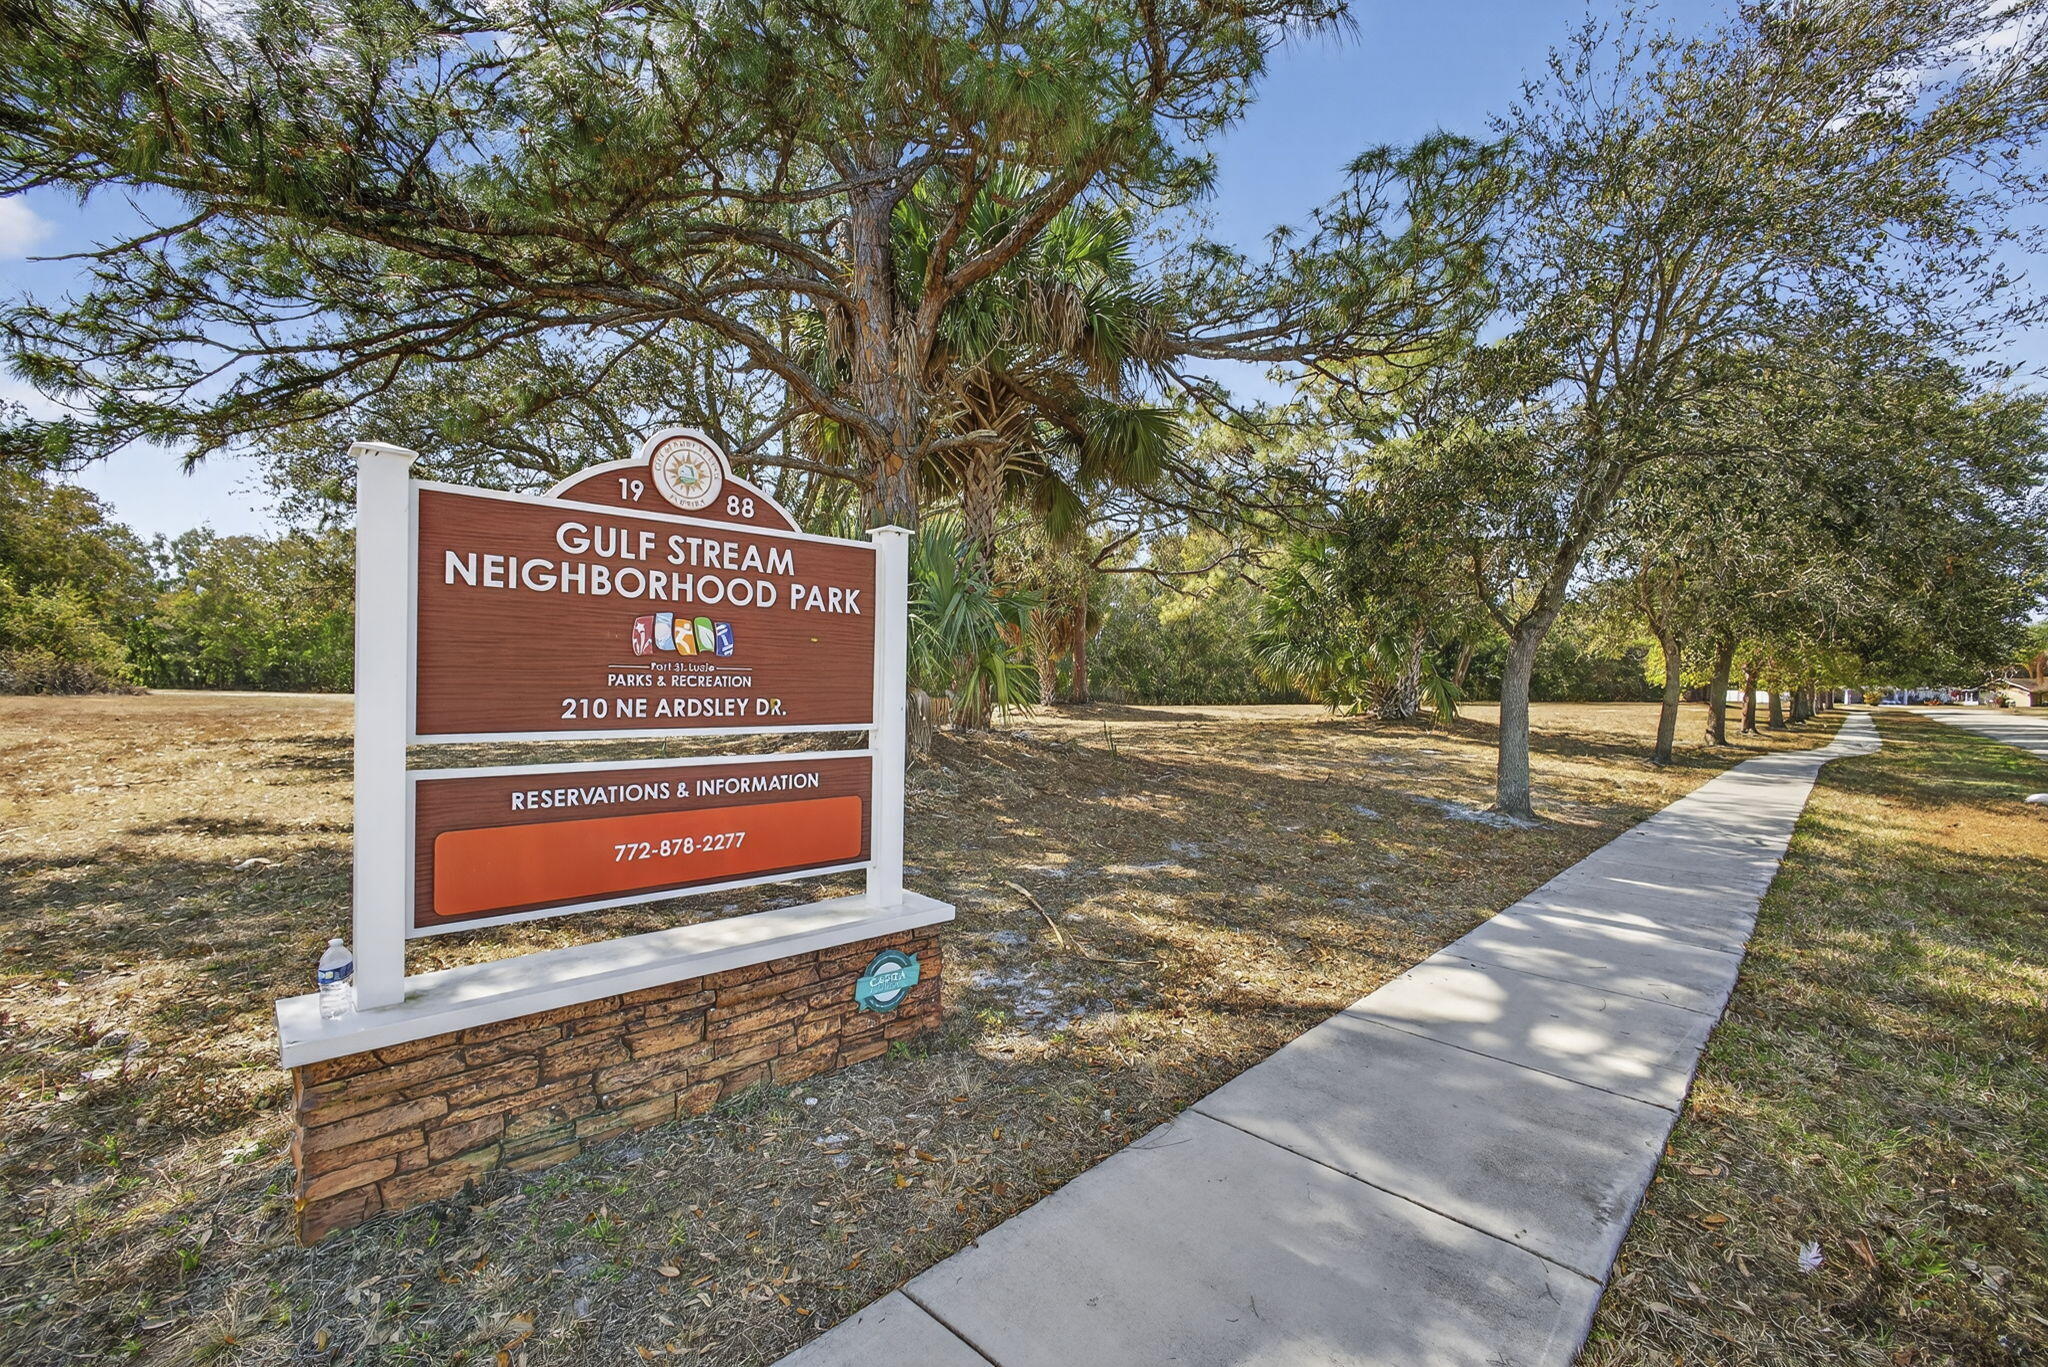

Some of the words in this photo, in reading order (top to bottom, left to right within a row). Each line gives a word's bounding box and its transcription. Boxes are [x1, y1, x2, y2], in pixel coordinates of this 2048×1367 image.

[618, 478, 644, 502] 19
[726, 494, 756, 519] 88
[555, 521, 656, 562] GULF
[666, 534, 795, 576] STREAM
[445, 550, 778, 608] NEIGHBORHOOD
[790, 583, 861, 615] PARK
[607, 673, 653, 687] PARKS
[656, 675, 667, 687] &
[671, 674, 752, 688] RECREATION
[561, 698, 608, 719] 210
[616, 698, 647, 718] NE
[654, 698, 749, 718] ARDSLEY
[756, 698, 787, 716] DR.
[511, 782, 670, 811] RESERVATIONS
[676, 782, 690, 798] &
[696, 772, 819, 797] INFORMATION
[614, 831, 746, 862] 772-878-2277
